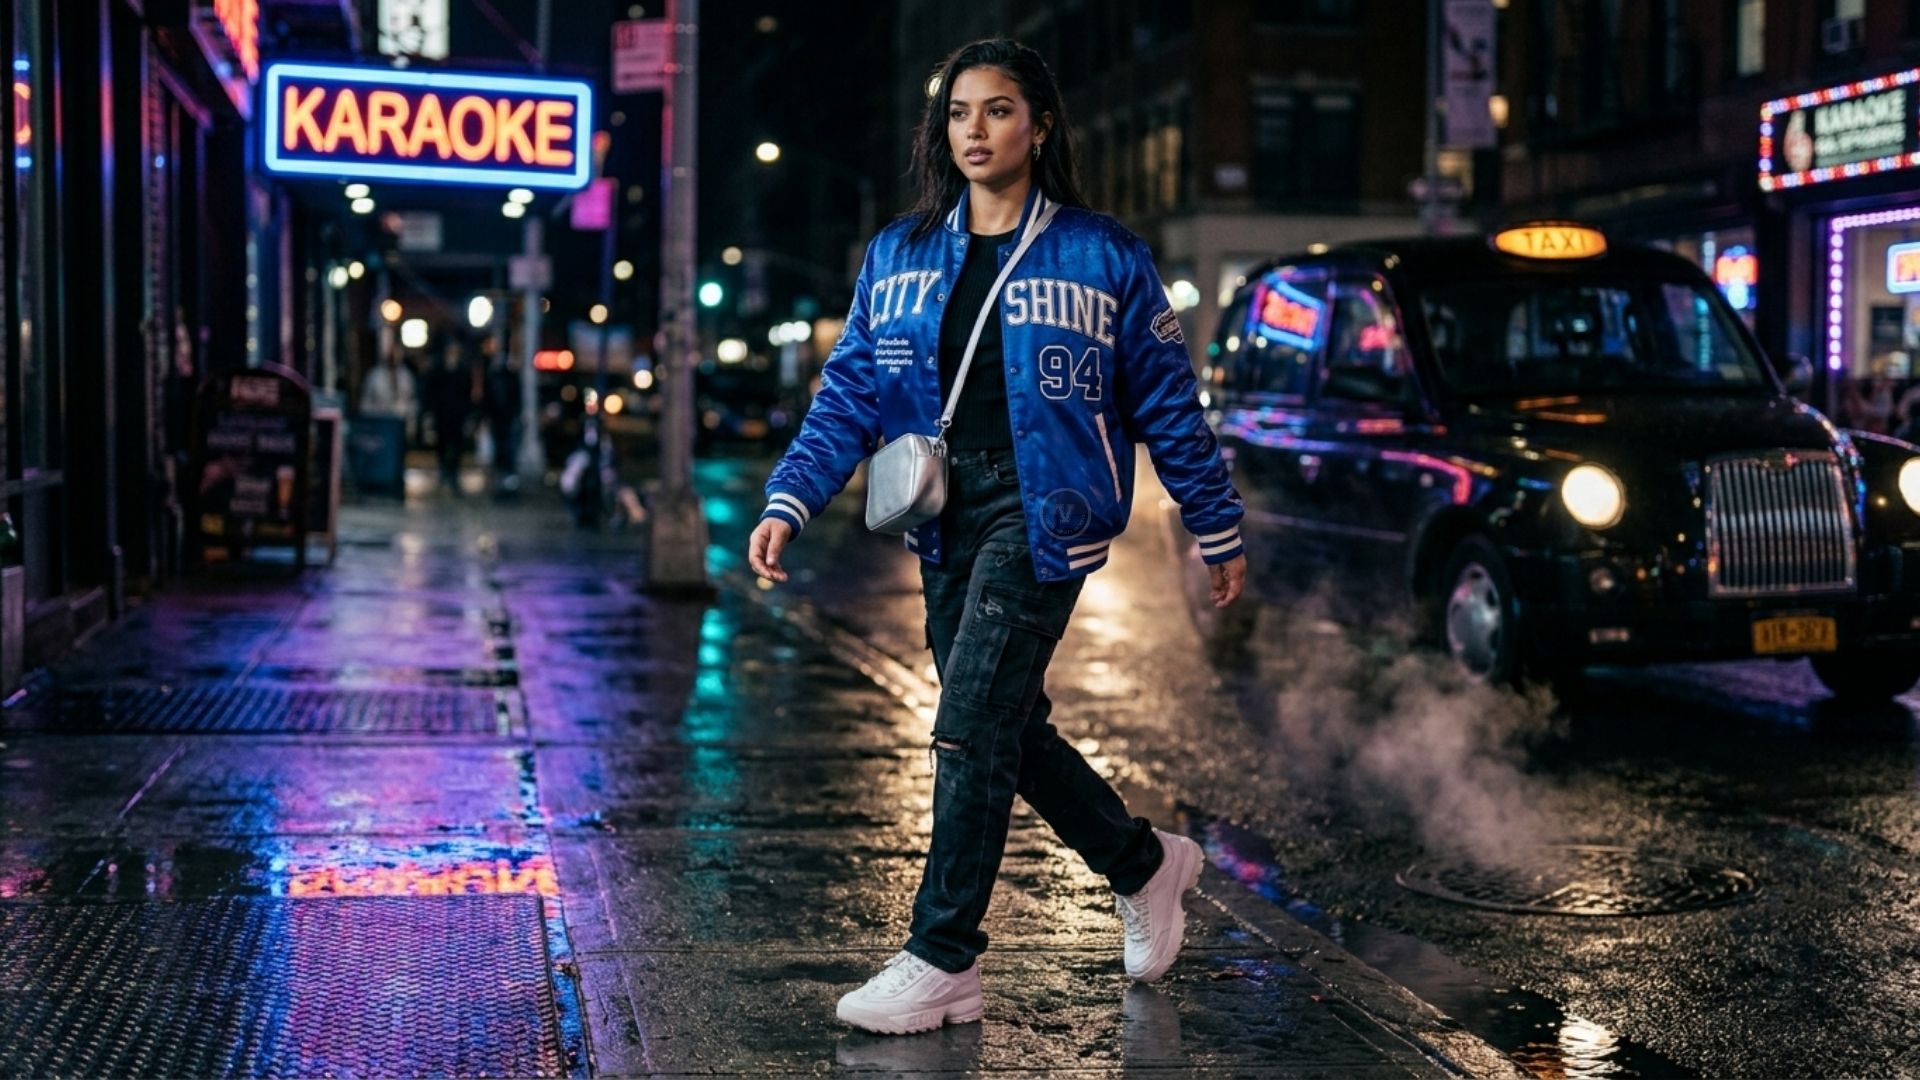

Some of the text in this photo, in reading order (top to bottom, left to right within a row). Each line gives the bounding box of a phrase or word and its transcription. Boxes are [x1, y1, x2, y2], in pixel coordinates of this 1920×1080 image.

[284, 86, 574, 167] KARAOKE
[1814, 89, 1907, 136] KARAOKE
[1522, 231, 1587, 251] TAXI
[869, 270, 942, 331] CITY
[1006, 278, 1118, 348] SHINE
[1038, 345, 1102, 402] 94
